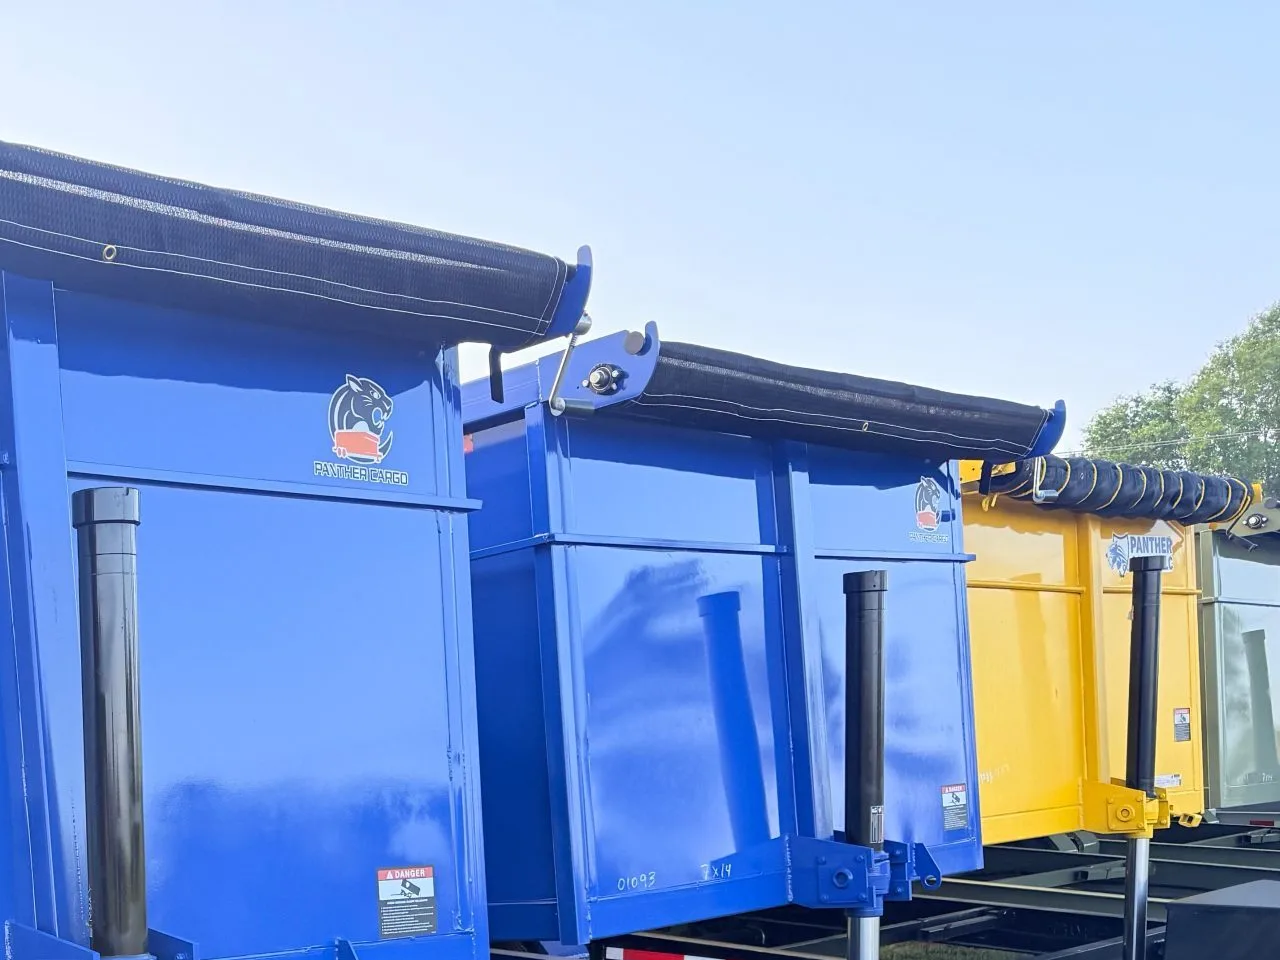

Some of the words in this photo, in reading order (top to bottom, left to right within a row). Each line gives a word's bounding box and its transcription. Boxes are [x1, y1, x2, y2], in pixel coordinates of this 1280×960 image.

[314, 461, 368, 481] PANTHER
[370, 467, 408, 486] CARGO
[1130, 535, 1173, 554] PANTHER
[394, 869, 425, 879] DANGER
[617, 872, 656, 891] 01093
